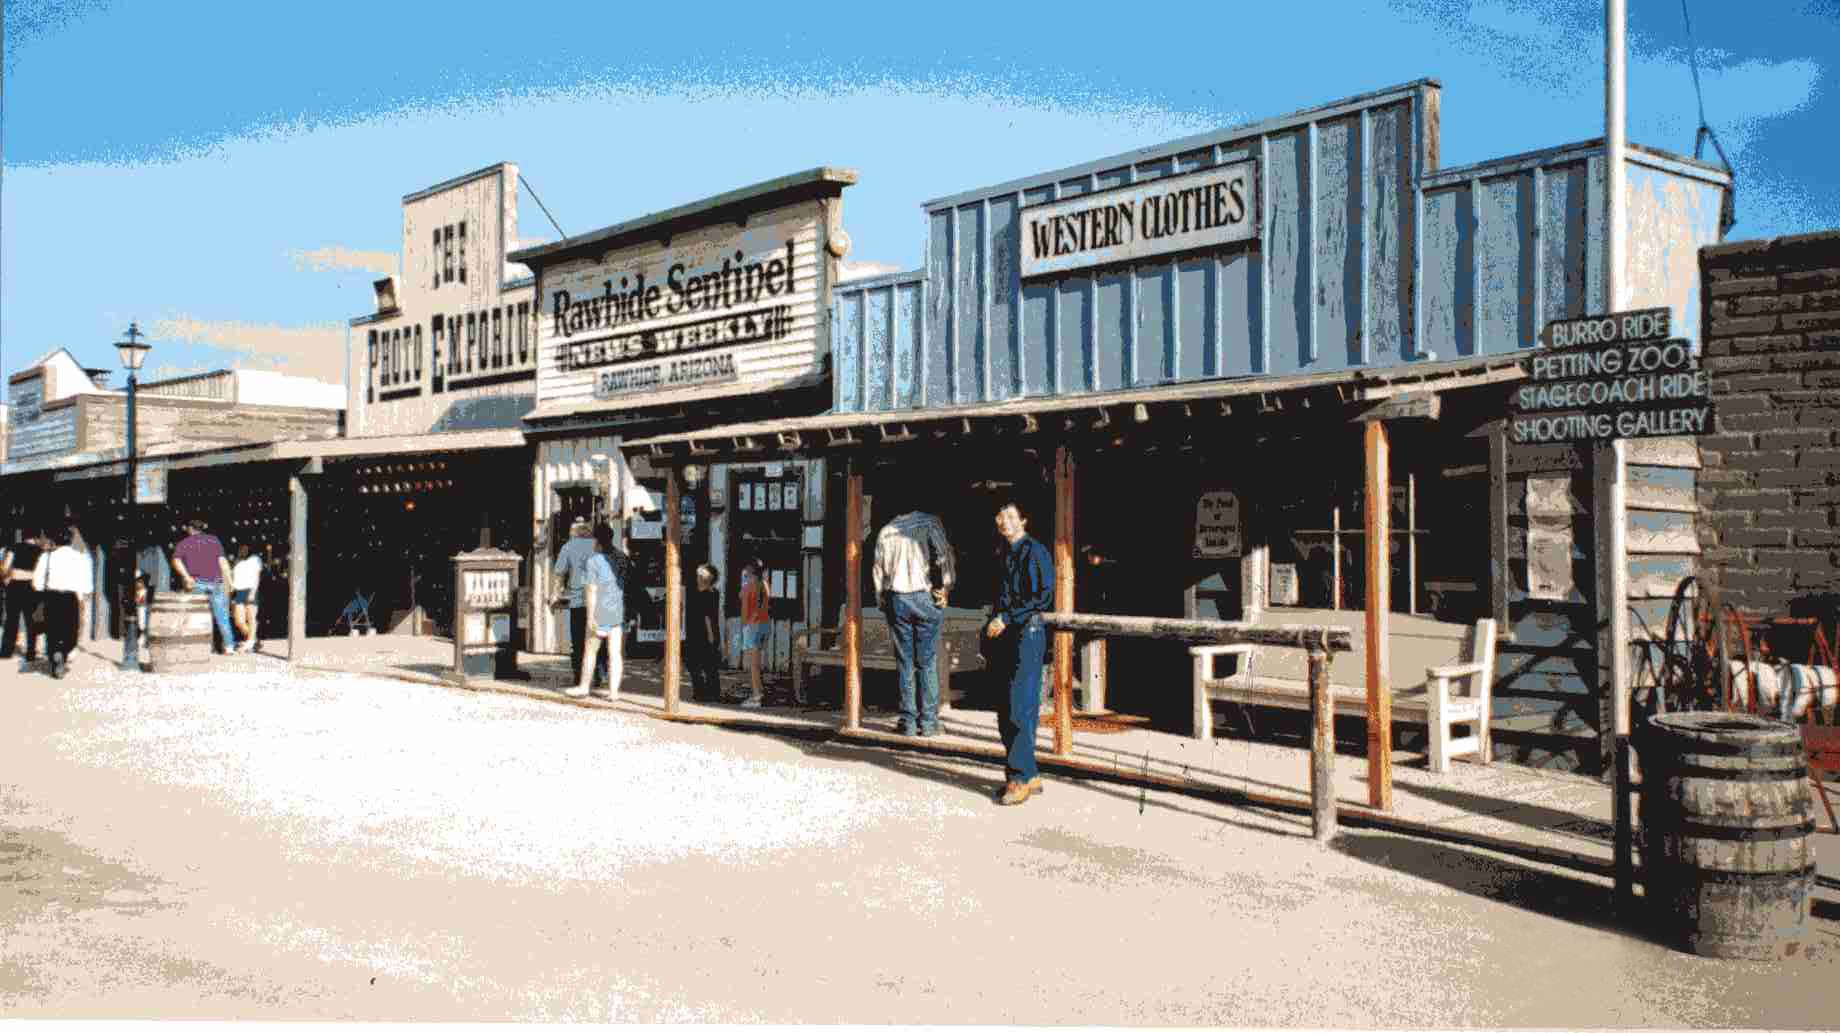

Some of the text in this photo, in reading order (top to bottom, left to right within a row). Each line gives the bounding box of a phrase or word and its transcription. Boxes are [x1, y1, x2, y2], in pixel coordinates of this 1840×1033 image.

[1030, 177, 1245, 259] WESTERN CLOTHES
[432, 221, 467, 290] THE
[553, 239, 796, 338] Rawhide Sentinel
[571, 312, 772, 365] NEWS WEEKLY
[1551, 311, 1666, 348] BURRO RIDE
[367, 323, 423, 404] PHOTO
[668, 353, 736, 384] ARIZONA
[1533, 343, 1685, 381] PETTING ZOO
[1518, 370, 1706, 410] STAGECOACH RIDE
[1512, 406, 1709, 443] SHOOTING GALLERY
